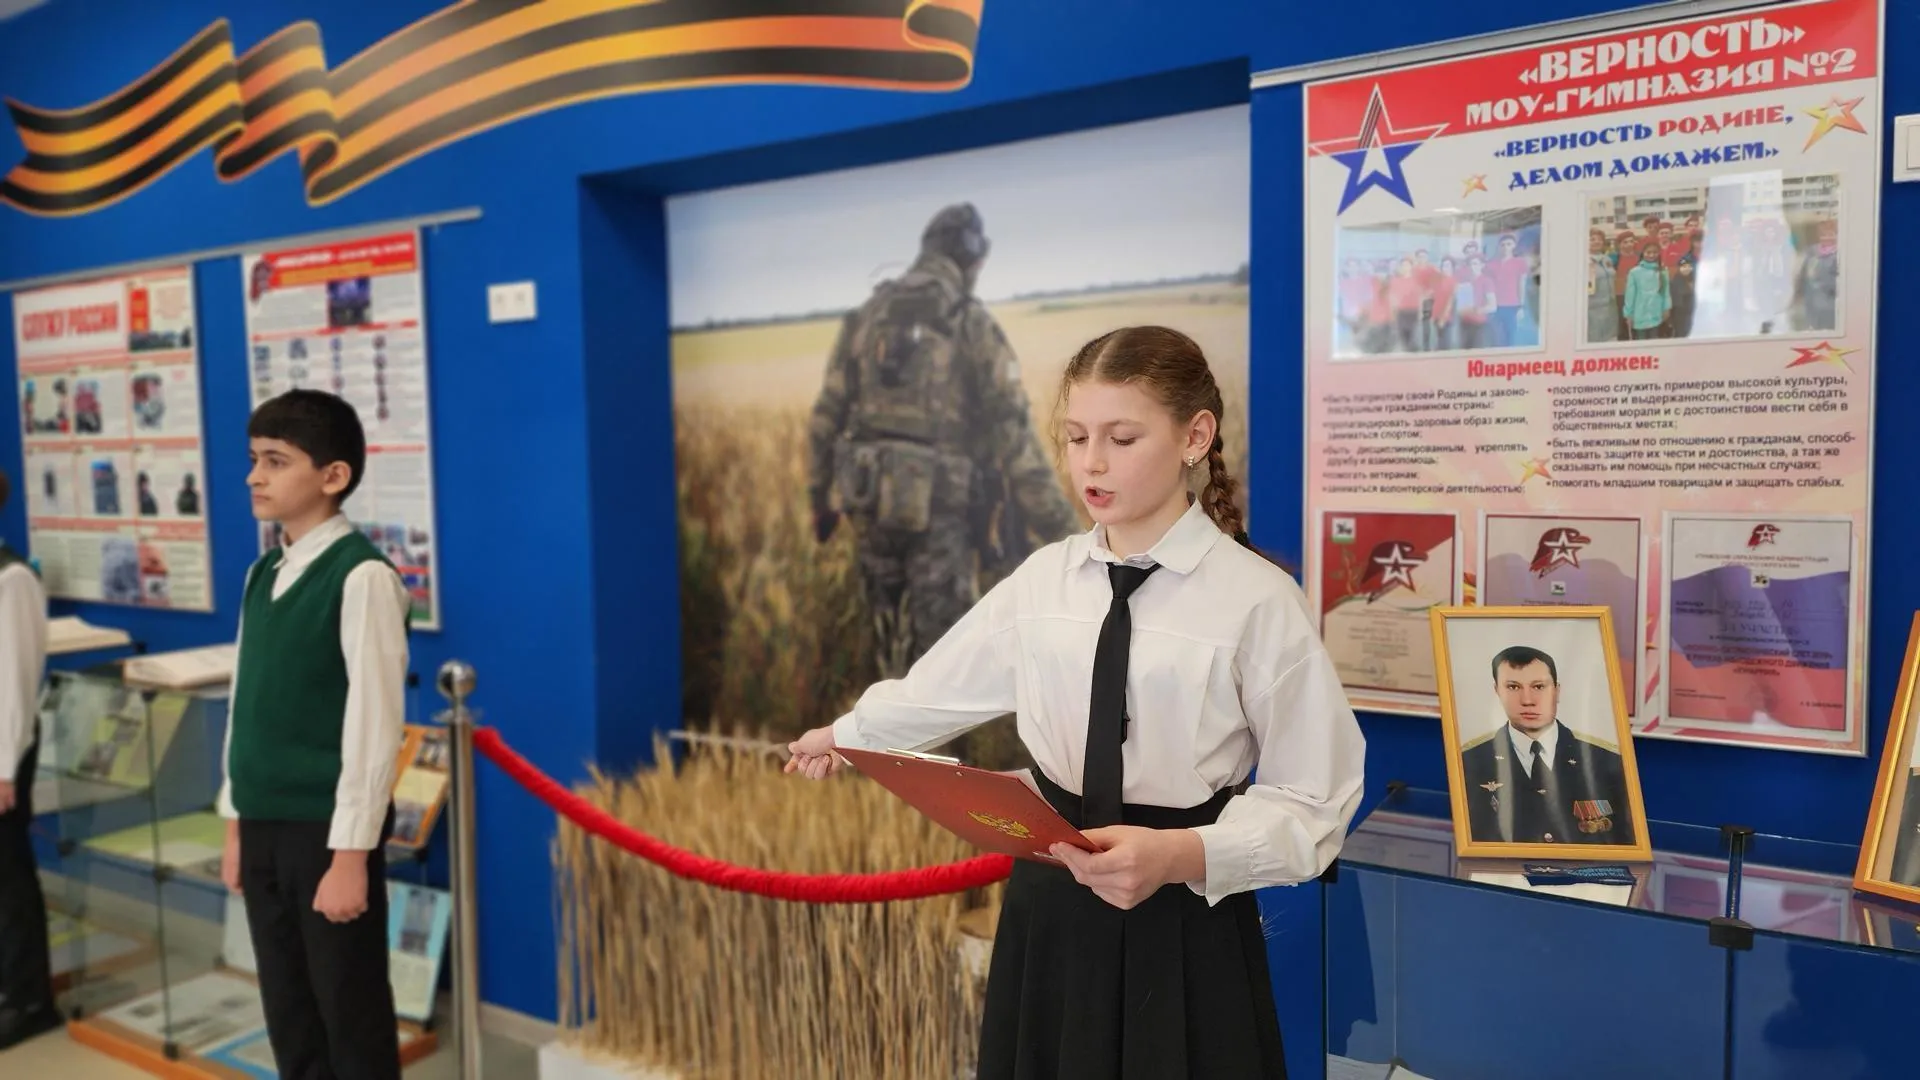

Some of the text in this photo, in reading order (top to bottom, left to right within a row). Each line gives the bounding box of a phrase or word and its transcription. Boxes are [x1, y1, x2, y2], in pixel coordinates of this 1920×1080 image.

[1518, 17, 1806, 85] «ВЕРНОСТЬ»
[1465, 47, 1857, 127] МОУ-ГИМНАЗИЯ №2
[1493, 105, 1793, 159] «ВЕРНОСТЬ РОДИНЕ,
[1508, 141, 1779, 191] ДЕЛОМ ДОКАЖЕМ»
[1467, 355, 1660, 380] Юнармеец должен:
[1552, 375, 1848, 395] постоянно служить примером высокой культуры,
[1405, 391, 1435, 401] своей
[1437, 389, 1478, 400] Родины
[1490, 388, 1529, 398] законо-
[1552, 396, 1618, 408] скромности
[1621, 396, 1629, 405] и
[1732, 389, 1774, 402] строго
[1776, 388, 1848, 400] соблюдать
[1385, 402, 1450, 414] гражданином
[1552, 401, 1849, 420] требования морали и с достоинством вести себя в
[1414, 417, 1461, 428] здоровый
[1463, 415, 1492, 427] образ
[1494, 415, 1528, 425] жизни,
[1552, 420, 1632, 432] общественных
[1552, 431, 1856, 448] быть вежливым по отношению к гражданам, способ-
[1475, 443, 1528, 454] укреплять
[1552, 447, 1840, 461] ствовать защите их чести и достоинства, а так же
[1552, 463, 1608, 472] оказывать
[1610, 462, 1625, 471] им
[1627, 461, 1673, 472] помощь
[1675, 461, 1696, 473] при
[1698, 460, 1766, 471] несчастных
[1552, 475, 1845, 490] помогать младшим товарищам и защищать слабых.
